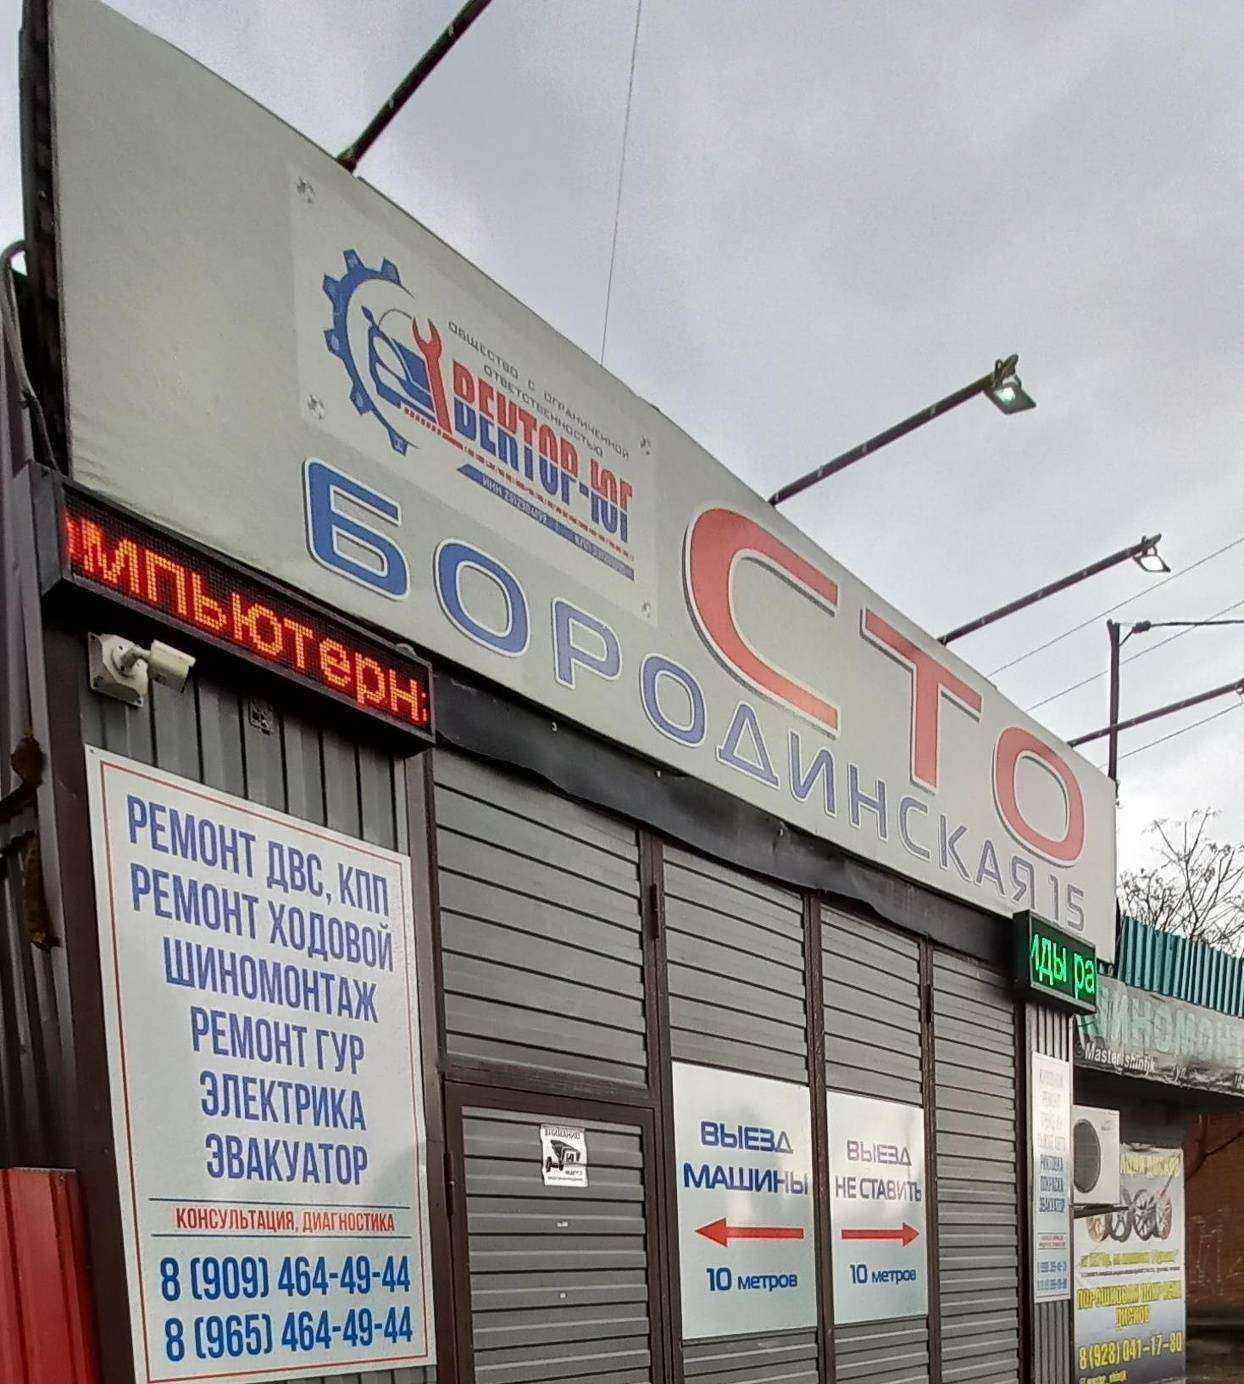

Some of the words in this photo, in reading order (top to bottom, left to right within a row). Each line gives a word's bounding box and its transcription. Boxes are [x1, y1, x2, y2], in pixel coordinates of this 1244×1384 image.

[449, 321, 519, 379] ОБЩЕСТВО
[453, 359, 633, 543] ВЕКТОР-ЮГ
[303, 456, 1035, 912] БОРОДИНСКАЯ
[1048, 874, 1084, 931] 15
[682, 507, 1086, 867] СТО
[127, 794, 256, 879] РЕМОНТ
[267, 840, 332, 906] ДВС,
[338, 862, 390, 917] КПП
[130, 862, 259, 940] РЕМОНТ
[268, 900, 394, 973] ХОДОВОЙ
[163, 936, 379, 1024] ШИНОМОНТАЖ
[190, 1005, 307, 1069] РЕМОНТ
[316, 1029, 365, 1075] ГУР
[200, 1070, 368, 1132] ЭЛЕКТРИКА
[205, 1132, 369, 1186] ЭВАКУАТОР
[700, 1120, 794, 1154] ВЫЕЗД
[846, 1139, 912, 1167] ВЫЕЗД
[683, 1162, 809, 1195] МАШИНЫ
[835, 1176, 857, 1199] НЕ
[859, 1177, 922, 1203] СТАВИТЬ
[175, 1207, 299, 1233] КОНСУЛЬТАЦИЯ,
[302, 1208, 396, 1234] ДИАГНОСТИКА
[159, 1257, 181, 1302] 8
[190, 1256, 269, 1300] (909)
[278, 1255, 411, 1297] 464-49-44
[706, 1267, 732, 1292] 10
[737, 1272, 798, 1294] метров
[850, 1264, 868, 1285] 10
[871, 1266, 917, 1289] метров
[164, 1317, 186, 1362] 8
[194, 1314, 273, 1359] (965)
[281, 1306, 413, 1352] 464-49-44
